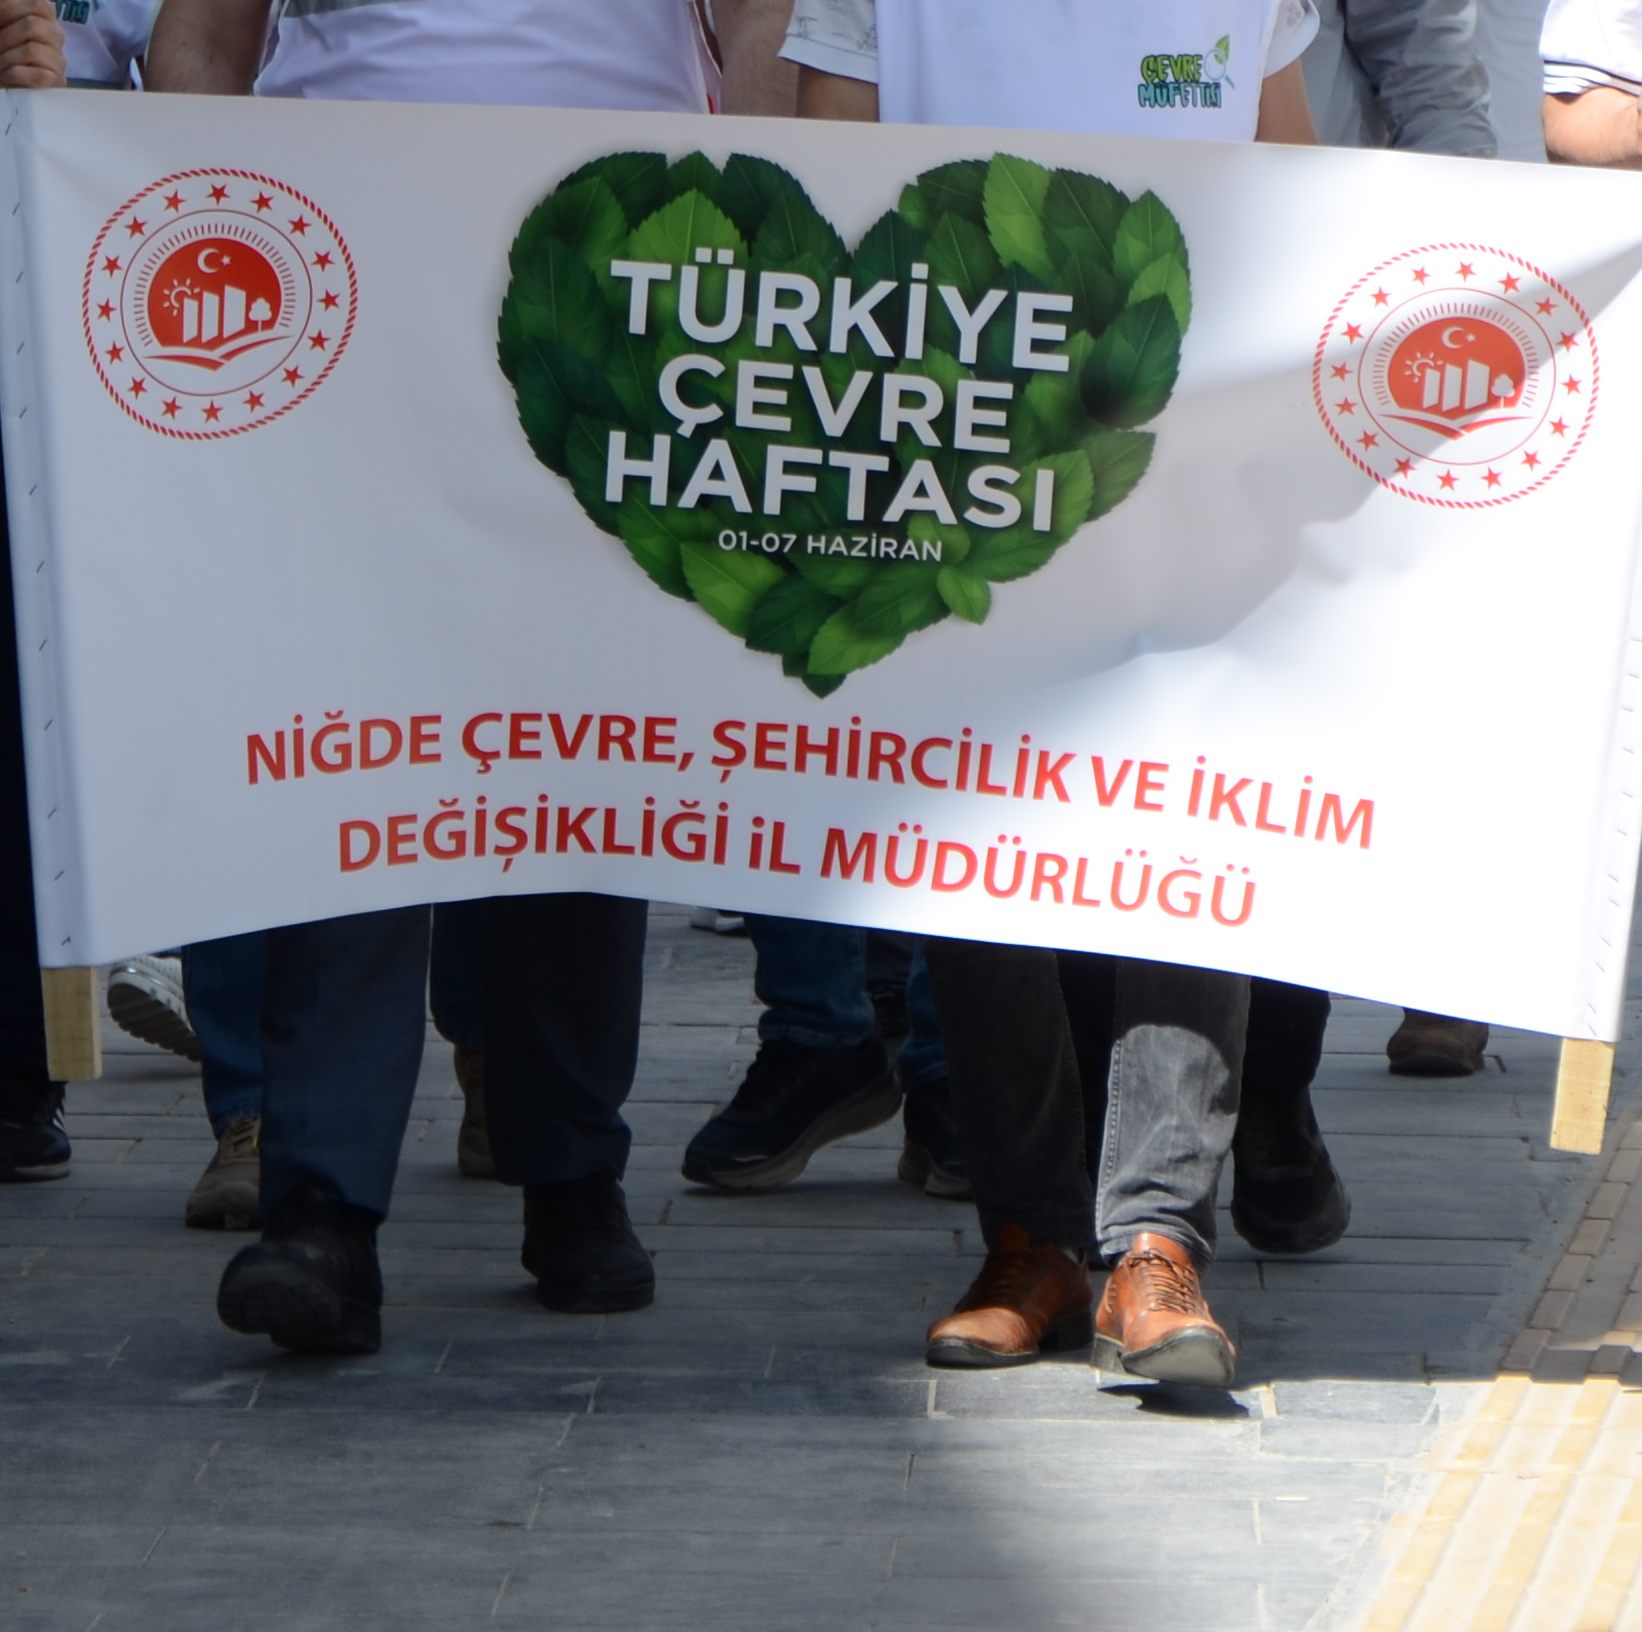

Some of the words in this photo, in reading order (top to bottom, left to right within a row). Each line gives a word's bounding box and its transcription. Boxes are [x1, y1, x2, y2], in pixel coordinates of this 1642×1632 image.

[1140, 53, 1204, 85] ÇEVRE
[609, 247, 1074, 373] TÜRKİYE
[657, 352, 1014, 455] ÇEVRE
[604, 429, 1056, 534] HAFTASI
[717, 528, 798, 554] 01-07
[805, 531, 944, 563] HAZİRAN
[245, 709, 442, 786] NİĞDE
[460, 711, 695, 774] ÇEVRE,
[710, 715, 1077, 804] ŞEHİRCİLİK
[1090, 754, 1166, 814] VE
[1186, 754, 1377, 851] İKLİM
[337, 794, 730, 874] DEĞİŞİKLİĞİ
[819, 822, 1257, 928] MÜDÜRLÜĞÜ
